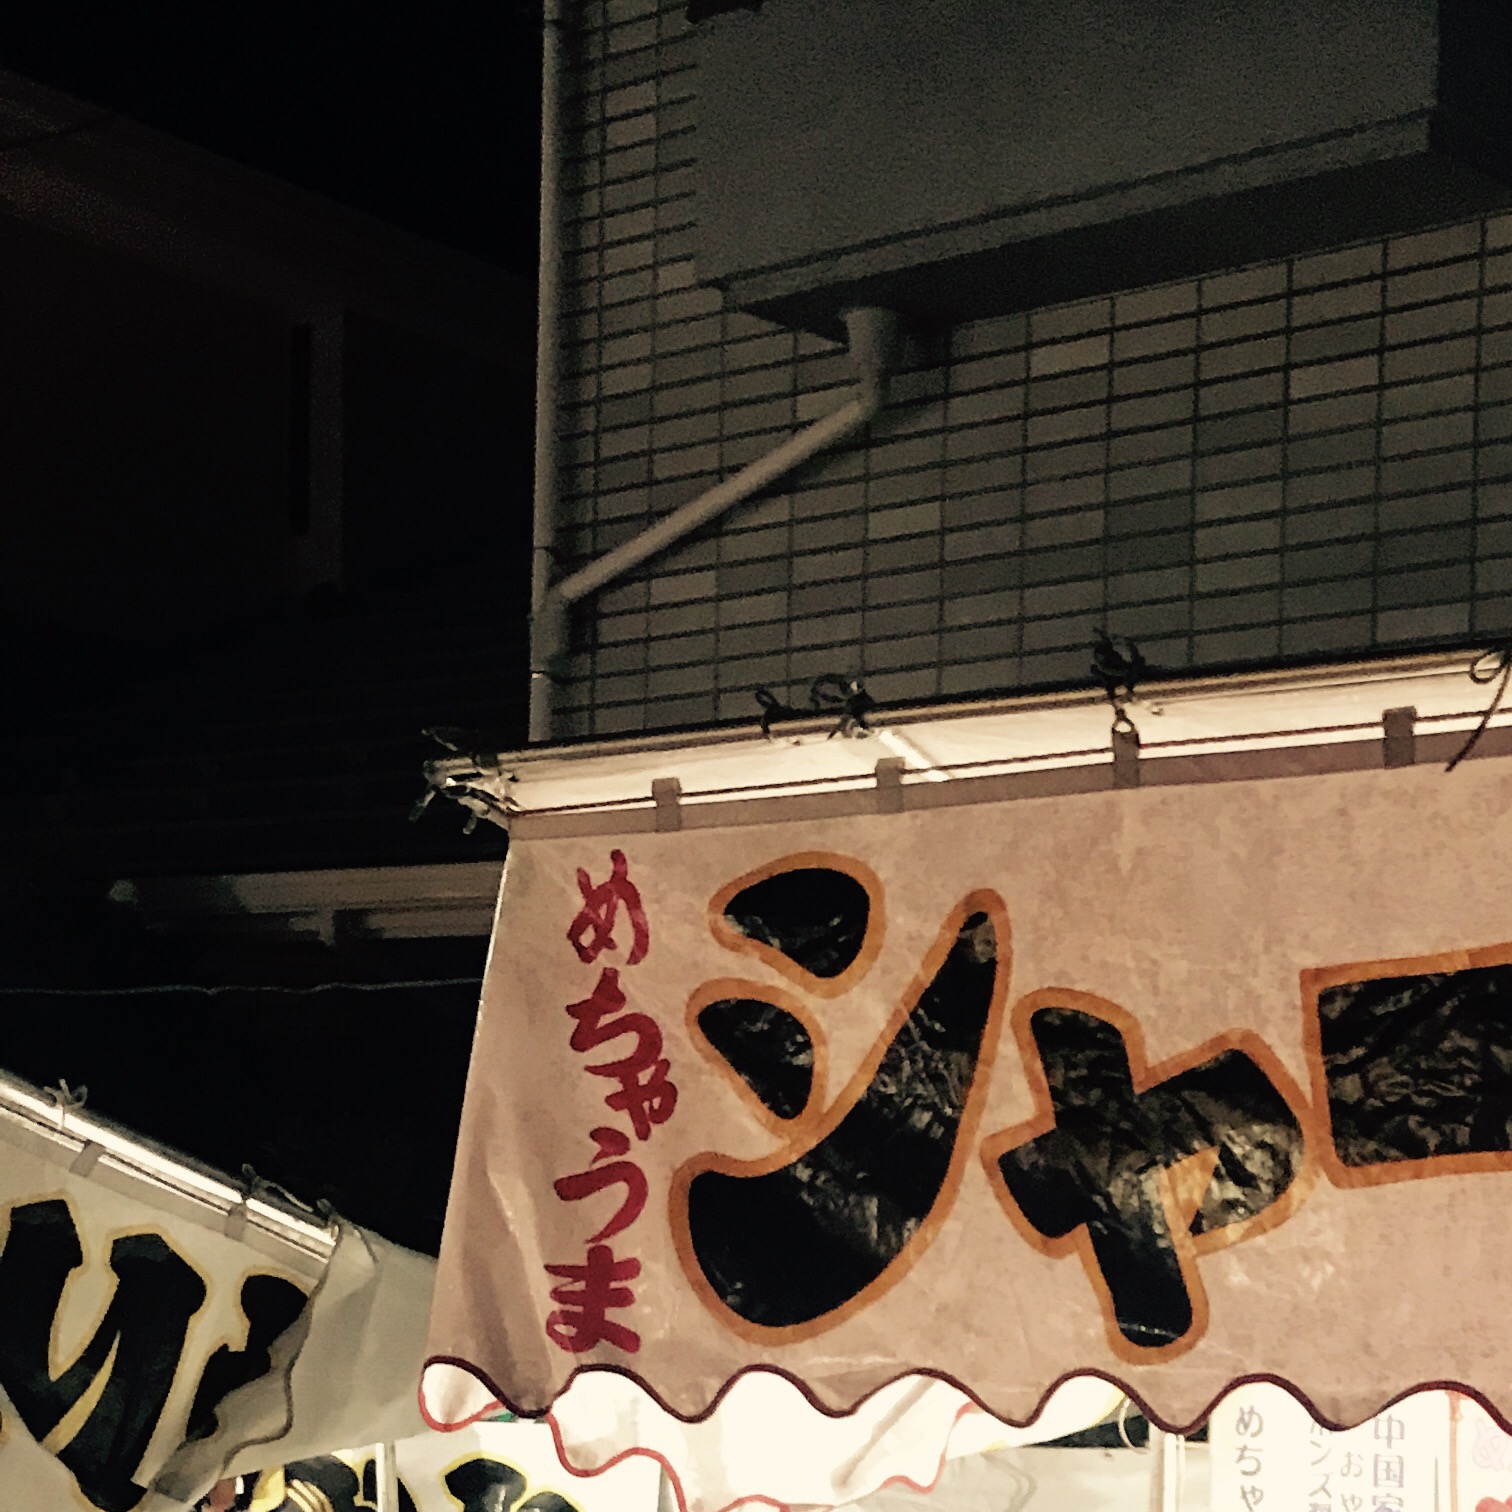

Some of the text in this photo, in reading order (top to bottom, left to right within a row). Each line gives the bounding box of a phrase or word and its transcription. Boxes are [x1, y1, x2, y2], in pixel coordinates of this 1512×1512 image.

[544, 849, 679, 1354] めちゃうま
